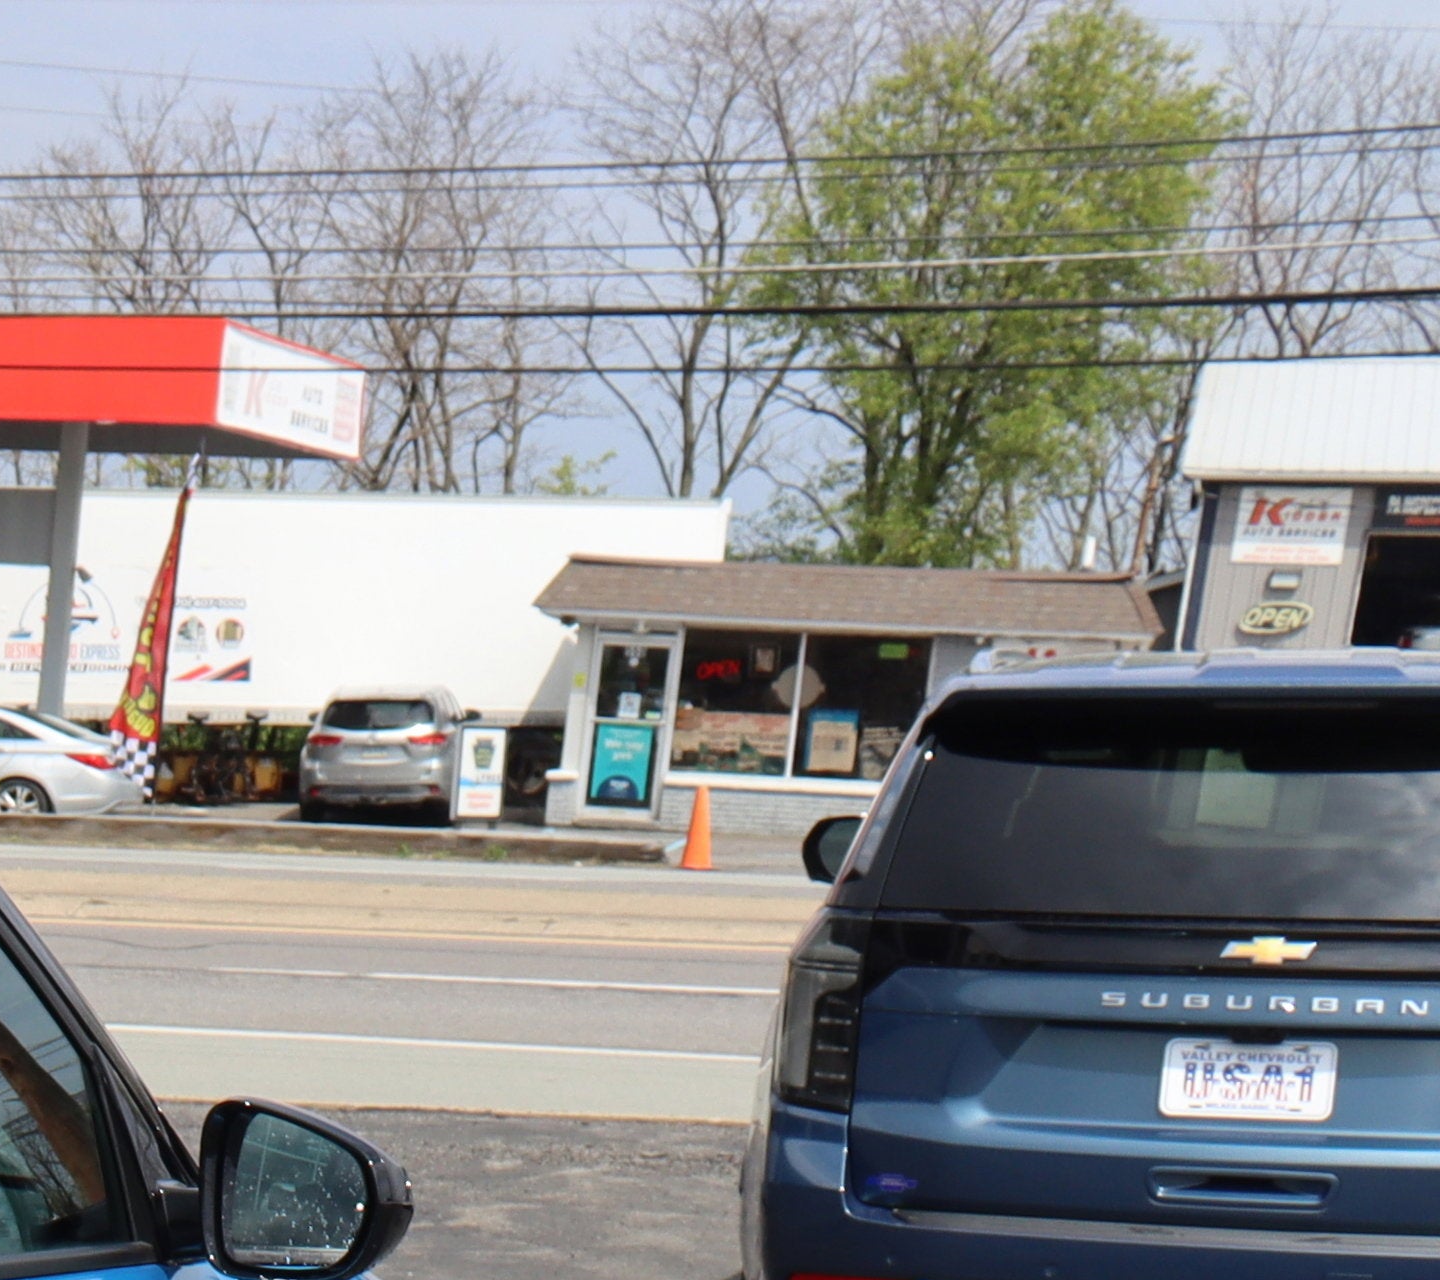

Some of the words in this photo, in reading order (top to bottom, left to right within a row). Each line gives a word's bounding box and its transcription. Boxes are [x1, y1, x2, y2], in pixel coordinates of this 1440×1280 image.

[1244, 606, 1306, 628] OPEN
[80, 643, 120, 660] EXPRESS
[696, 659, 742, 680] OPEN
[1100, 990, 1429, 1017] SUBURBAN
[1181, 1050, 1232, 1063] VALLEY
[1236, 1051, 1323, 1065] CHEVROLET
